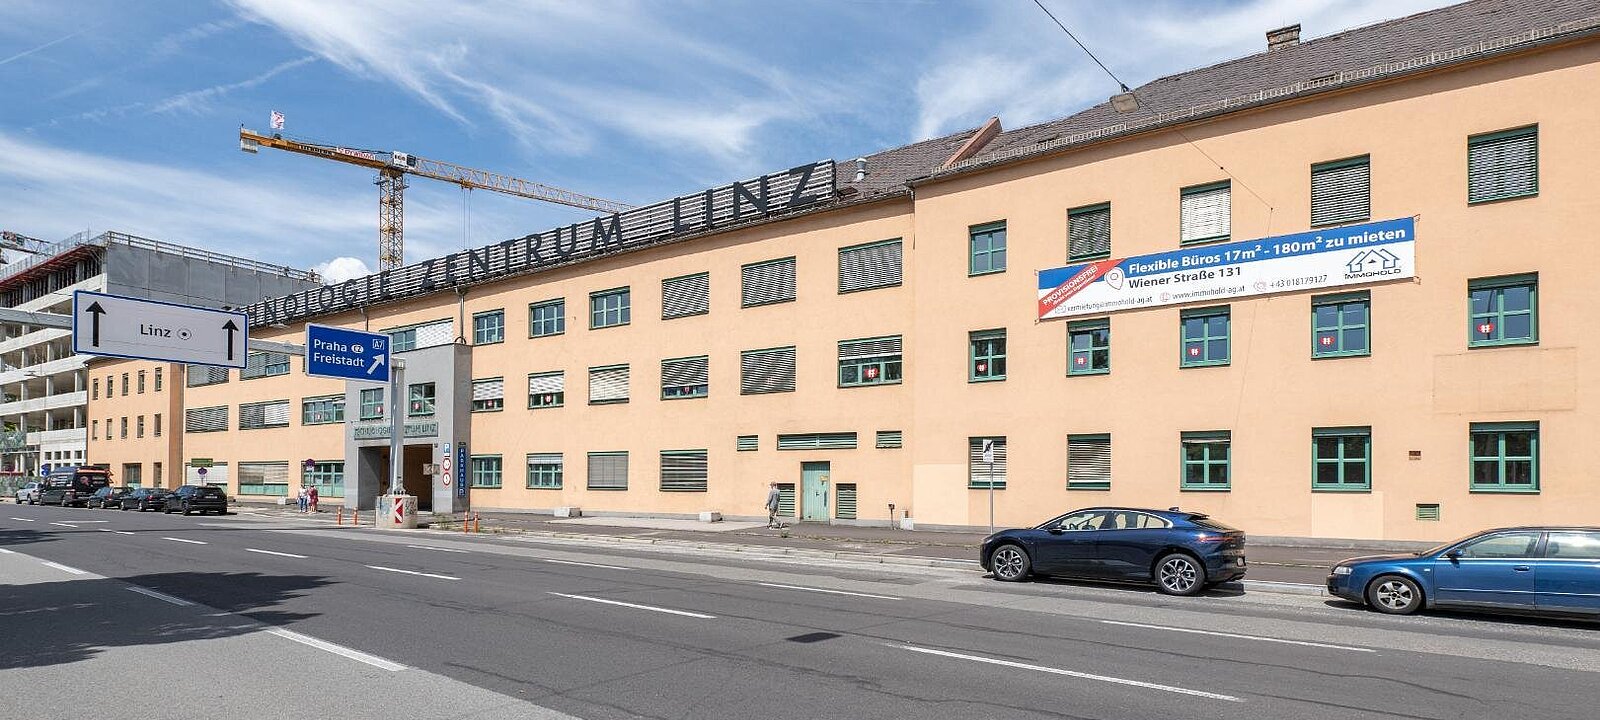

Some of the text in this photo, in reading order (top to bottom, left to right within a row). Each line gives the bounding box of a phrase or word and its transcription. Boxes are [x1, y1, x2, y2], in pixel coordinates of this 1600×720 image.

[421, 212, 624, 290] ZENTRUM
[673, 162, 818, 233] LINZ
[1129, 258, 1179, 274] Flexible
[1182, 254, 1221, 267] Büros
[1326, 236, 1344, 249] zu
[1348, 227, 1406, 245] mieten
[1129, 266, 1241, 289] Wiener Straße 131
[1344, 268, 1402, 280] IMMOHOLD
[140, 324, 171, 338] Linz
[314, 339, 347, 352] Praha
[314, 352, 365, 367] Freistadt
